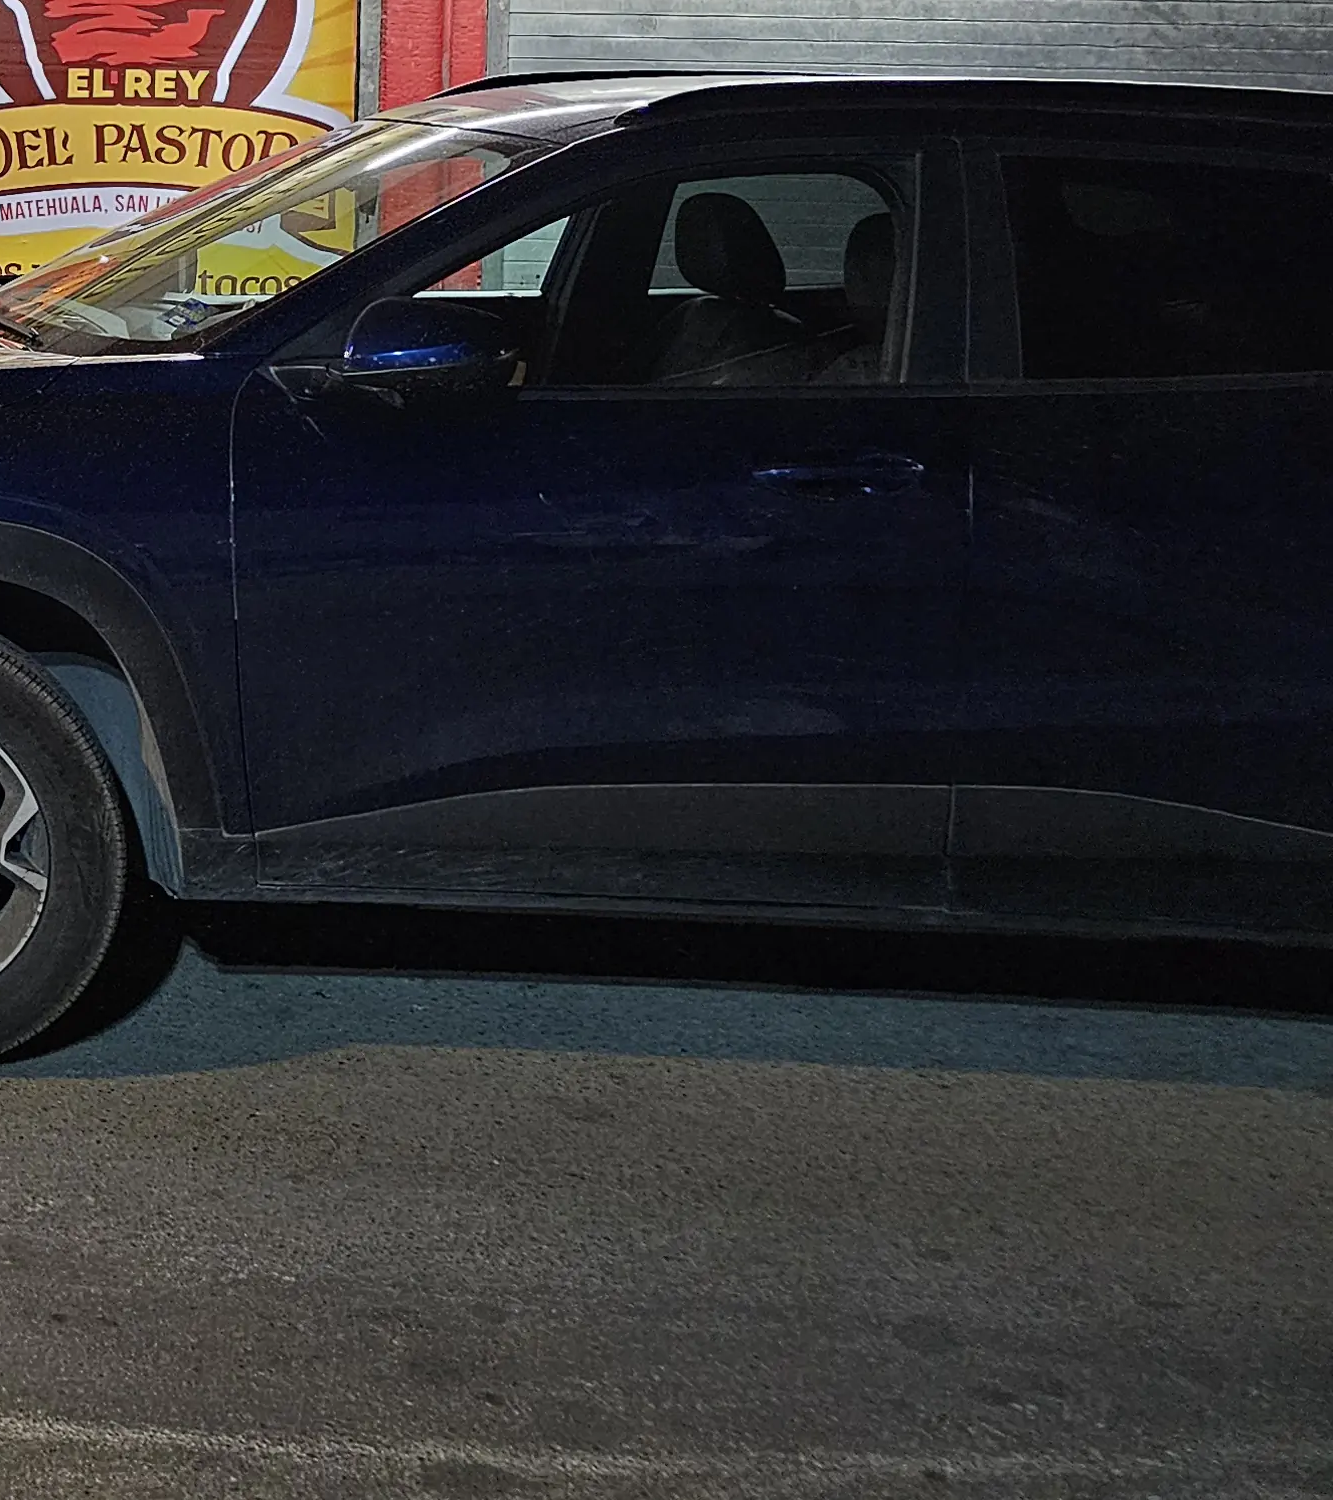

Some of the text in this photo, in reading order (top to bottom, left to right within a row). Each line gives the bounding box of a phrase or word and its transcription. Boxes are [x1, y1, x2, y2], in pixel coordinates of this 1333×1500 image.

[67, 68, 210, 100] EL REY
[0, 194, 108, 221] MATEHUALA,
[115, 194, 149, 213] SAN
[198, 268, 304, 297] tacos
